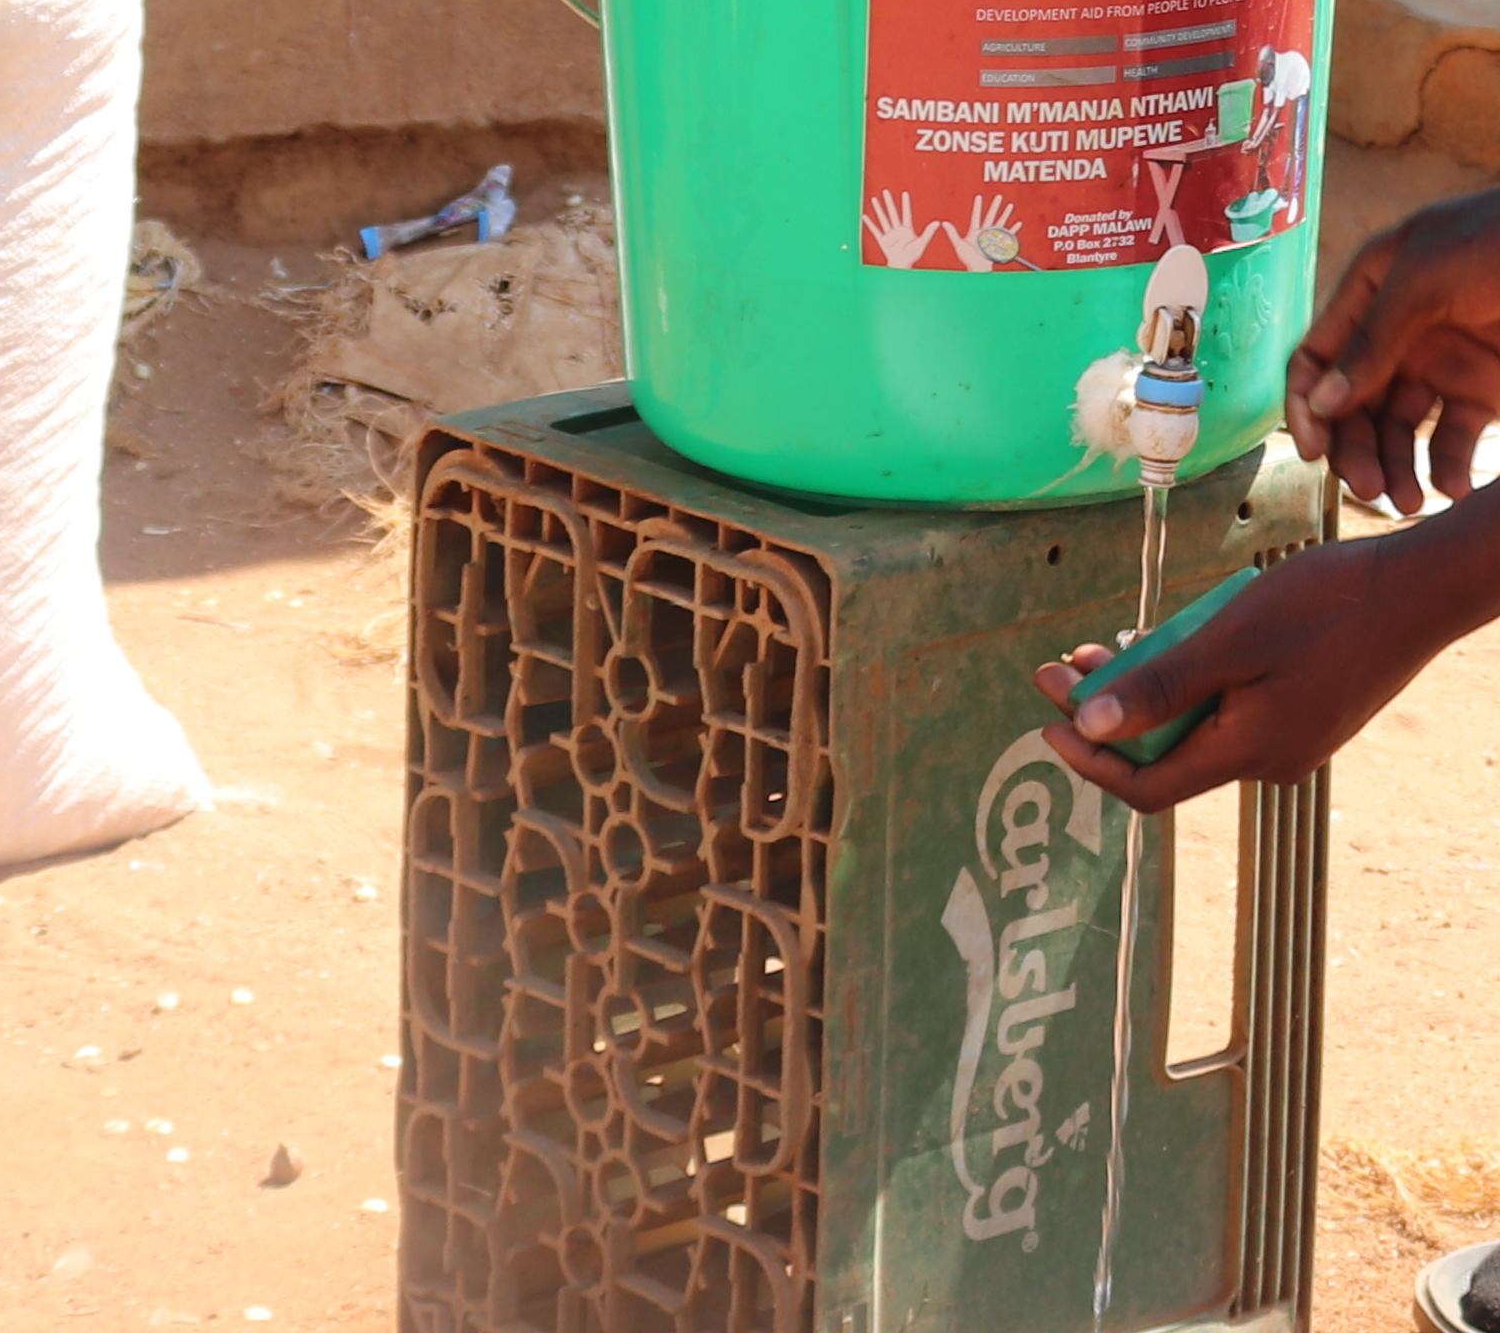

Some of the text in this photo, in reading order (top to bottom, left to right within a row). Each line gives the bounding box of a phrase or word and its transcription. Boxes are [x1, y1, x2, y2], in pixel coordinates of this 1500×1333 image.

[976, 7, 1078, 22] DEVELOPMENT
[1080, 7, 1104, 19] AID
[1106, 4, 1146, 18] FROM
[982, 42, 1046, 53] AGRICULTURE
[1124, 33, 1177, 48] COMMUNITY
[981, 73, 1035, 83] EDUCATION
[1124, 65, 1159, 78] HEALTH
[876, 86, 1214, 124] SAMBANI M'MANJA NTHAWI
[915, 120, 1183, 153] ZONSE KUTI MUPEWE
[983, 158, 1108, 182] MATENDA
[1064, 209, 1134, 224] Donated by
[1047, 217, 1152, 238] DAPP MALAWI
[1077, 239, 1101, 250] Box
[1102, 235, 1135, 248] 2732
[1066, 252, 1118, 264] Blantyre
[962, 726, 1101, 1242] Carlsberg
